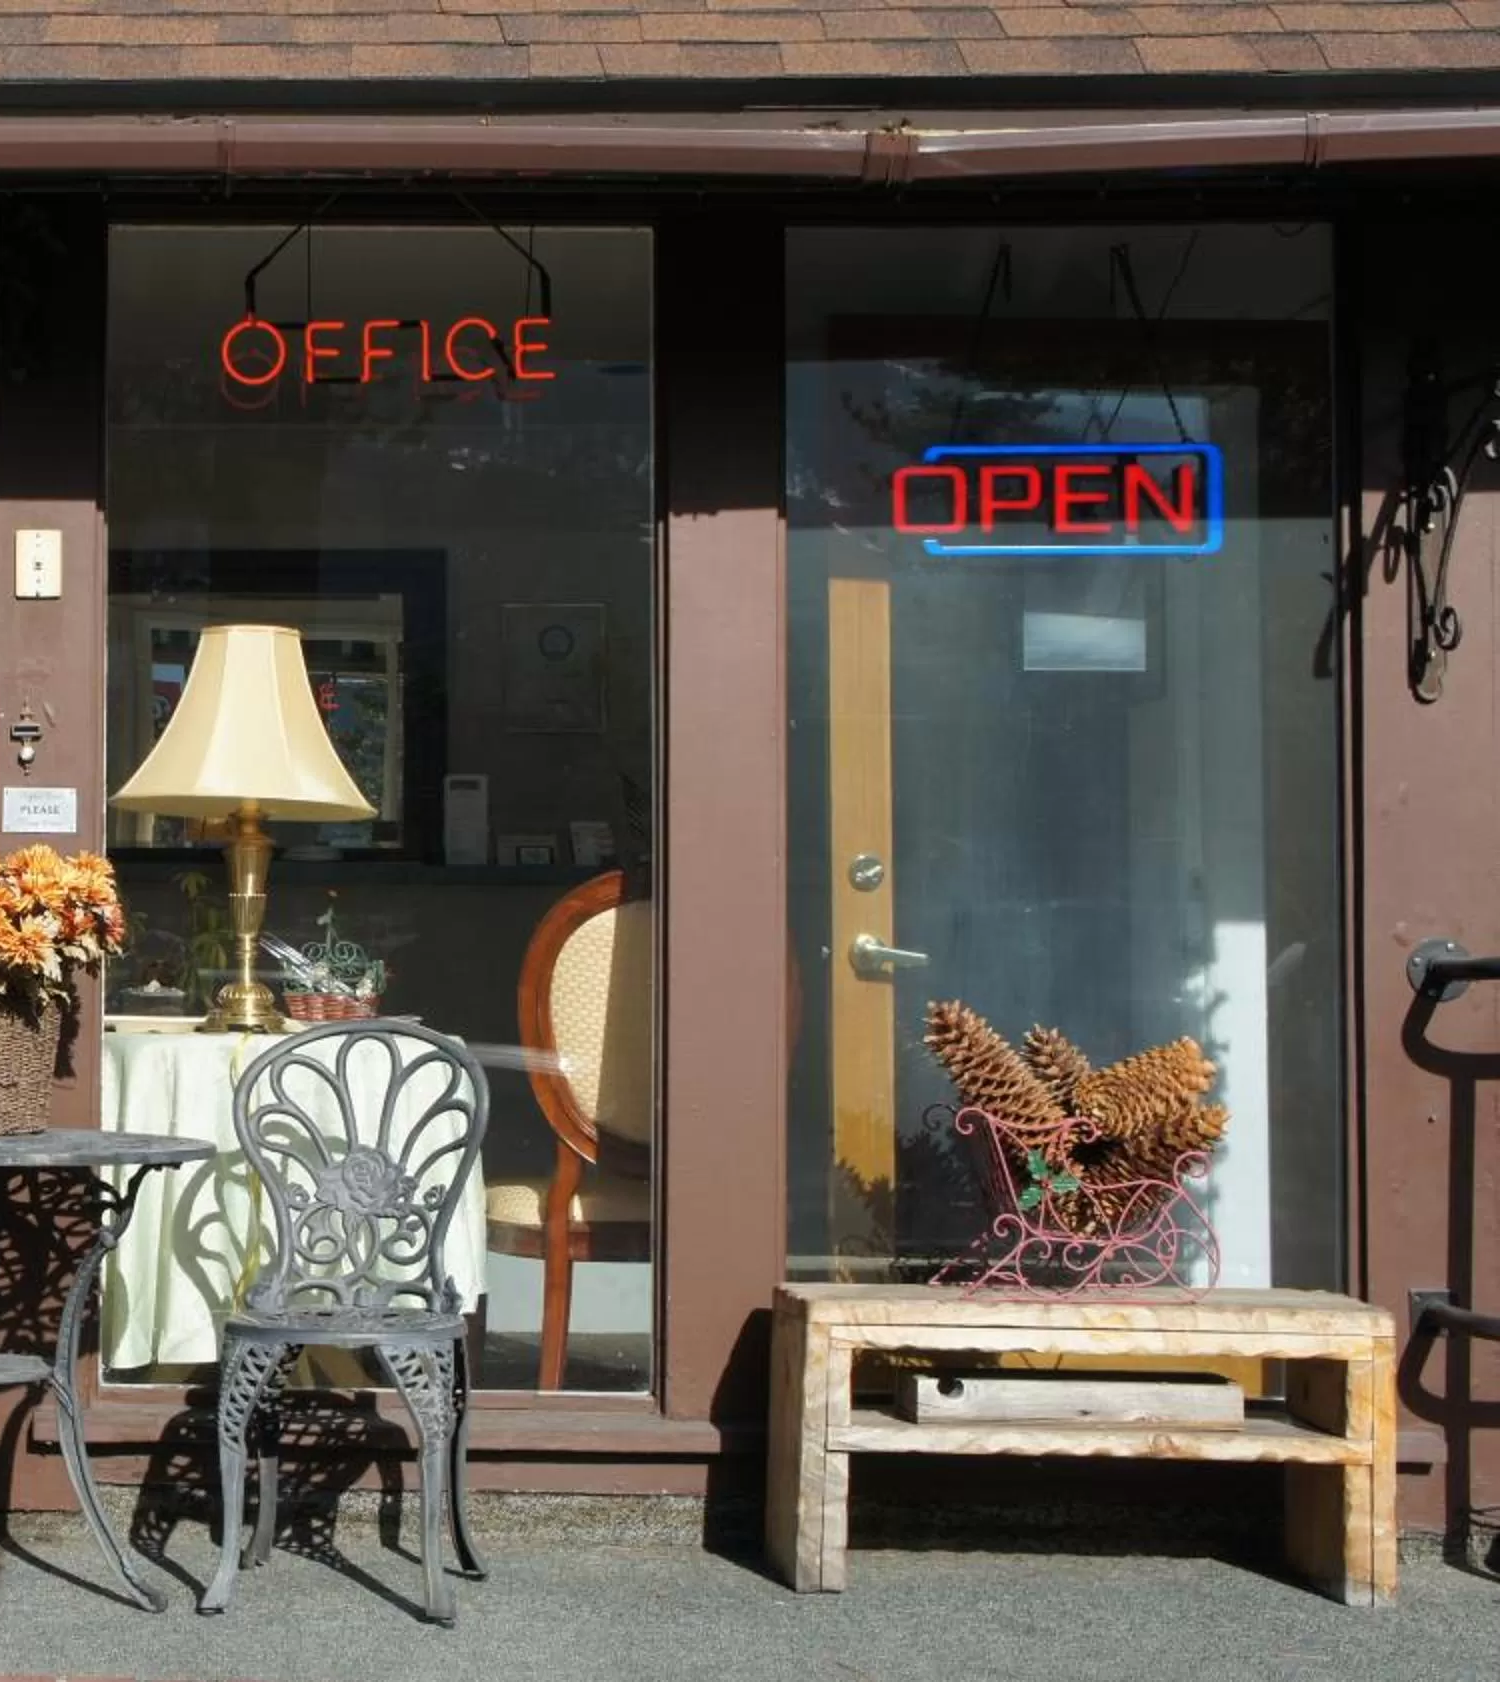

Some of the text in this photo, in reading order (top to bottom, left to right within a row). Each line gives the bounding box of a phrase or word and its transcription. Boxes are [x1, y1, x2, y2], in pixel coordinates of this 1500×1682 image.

[221, 317, 556, 386] OFFICE
[892, 464, 1195, 535] OPEN
[19, 804, 61, 815] PLEASE
